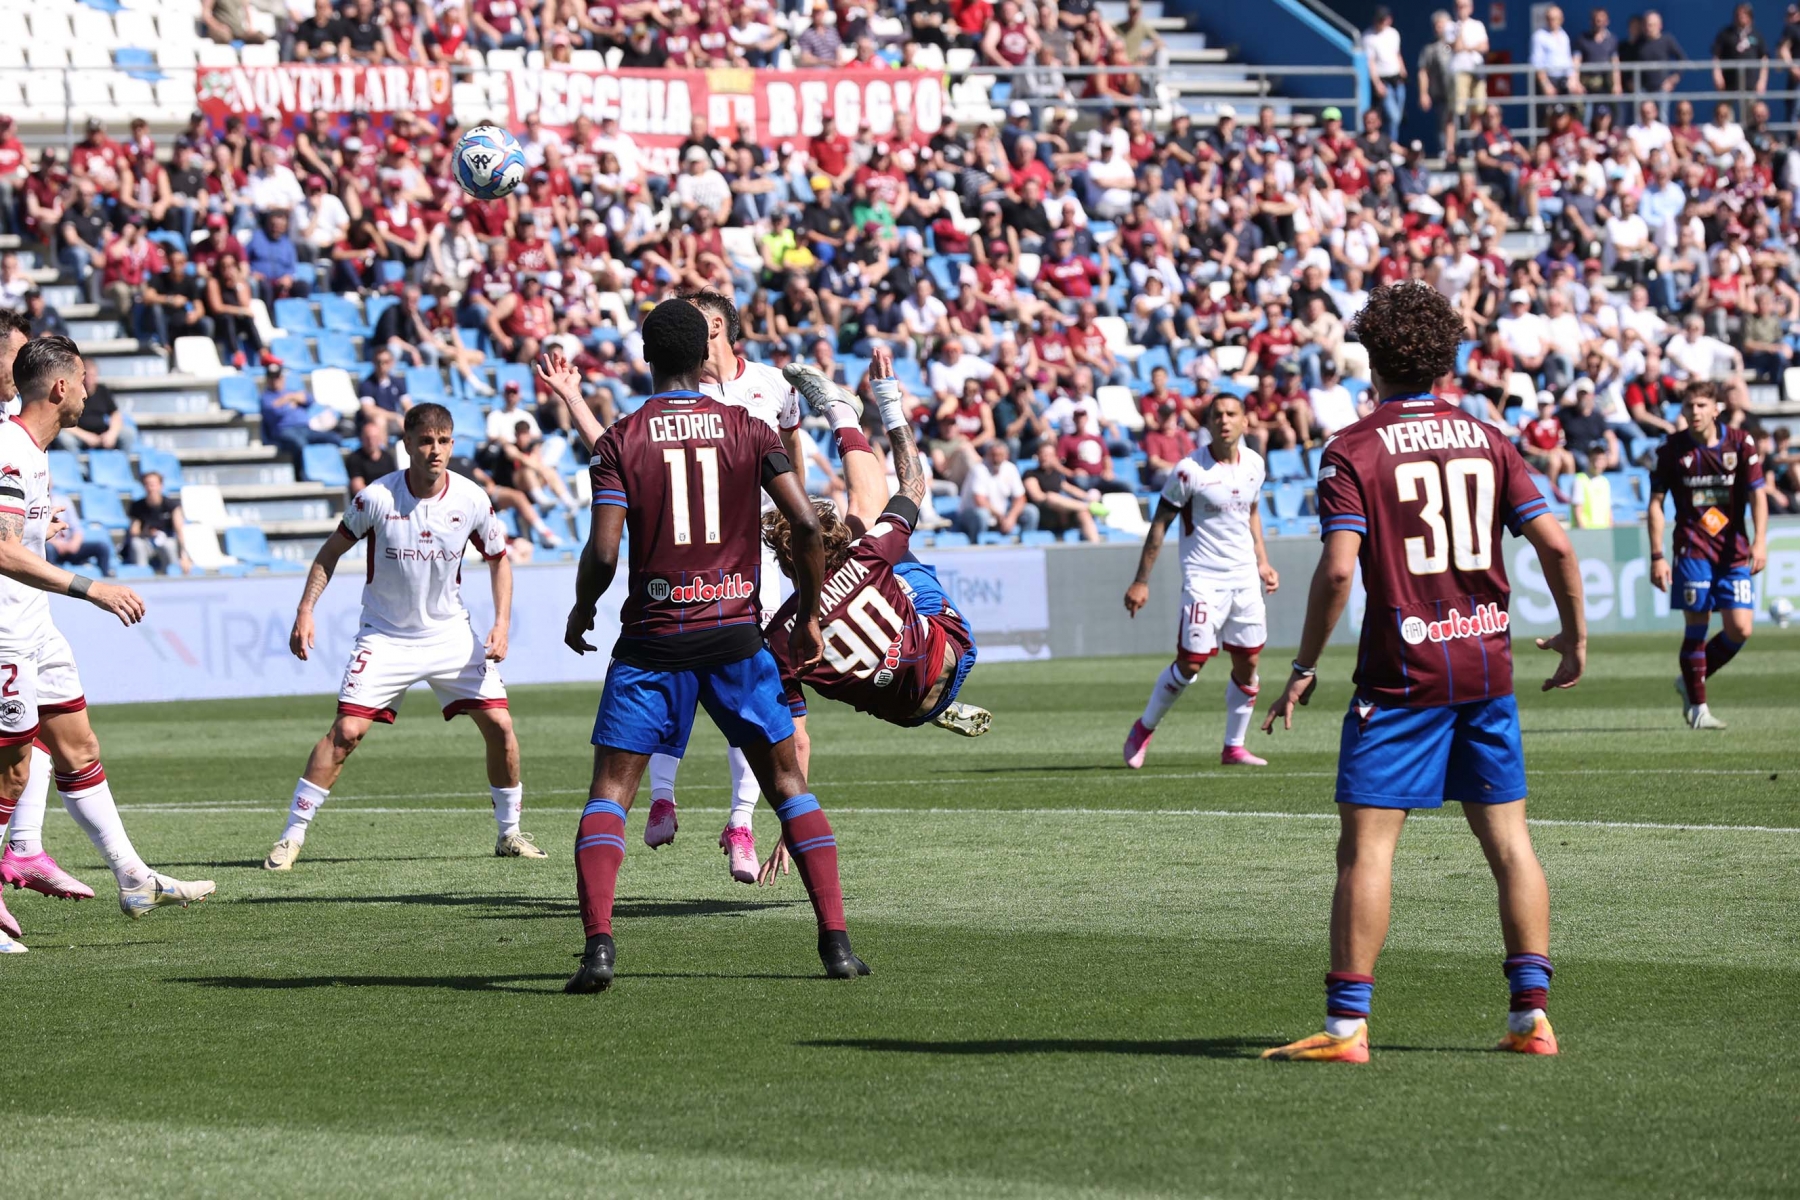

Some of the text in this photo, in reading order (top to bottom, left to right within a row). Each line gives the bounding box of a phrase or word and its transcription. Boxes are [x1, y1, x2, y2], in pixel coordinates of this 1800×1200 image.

[230, 66, 434, 112] NOVELLARA
[512, 68, 692, 135] VECCHIA
[649, 413, 725, 442] CEDRIC
[1376, 419, 1490, 455] VERGARA
[662, 447, 721, 545] 11
[1394, 458, 1496, 576] 30
[385, 547, 462, 561] SIRMAX
[650, 573, 754, 602] FIAT autostile
[783, 557, 870, 633] PANOVA
[1189, 602, 1207, 624] 16
[1405, 603, 1509, 641] FIAT autostile
[821, 585, 904, 680] 90
[1, 664, 19, 697] 2
[350, 650, 372, 674] 5
